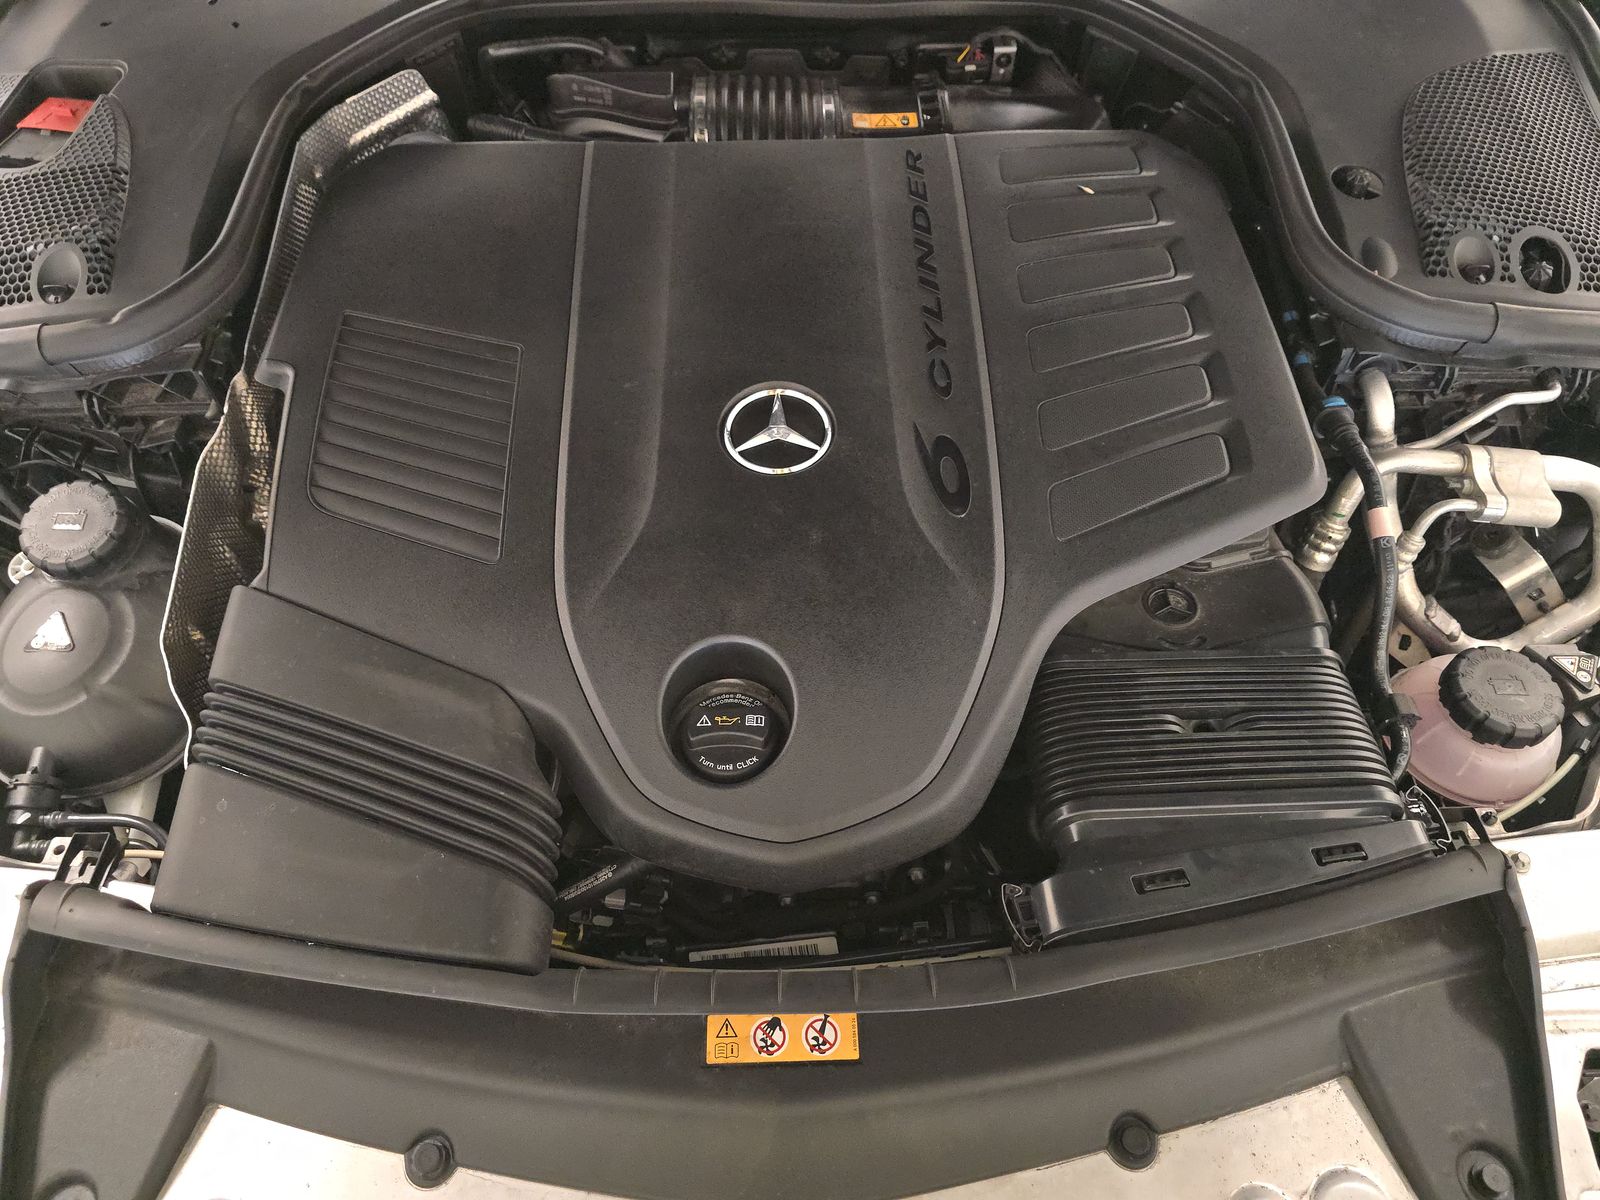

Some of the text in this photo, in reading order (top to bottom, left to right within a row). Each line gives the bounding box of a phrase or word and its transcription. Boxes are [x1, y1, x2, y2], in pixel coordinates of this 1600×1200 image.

[905, 148, 972, 518] 6 CYLINDER
[699, 755, 760, 771] Turn until CLICK
